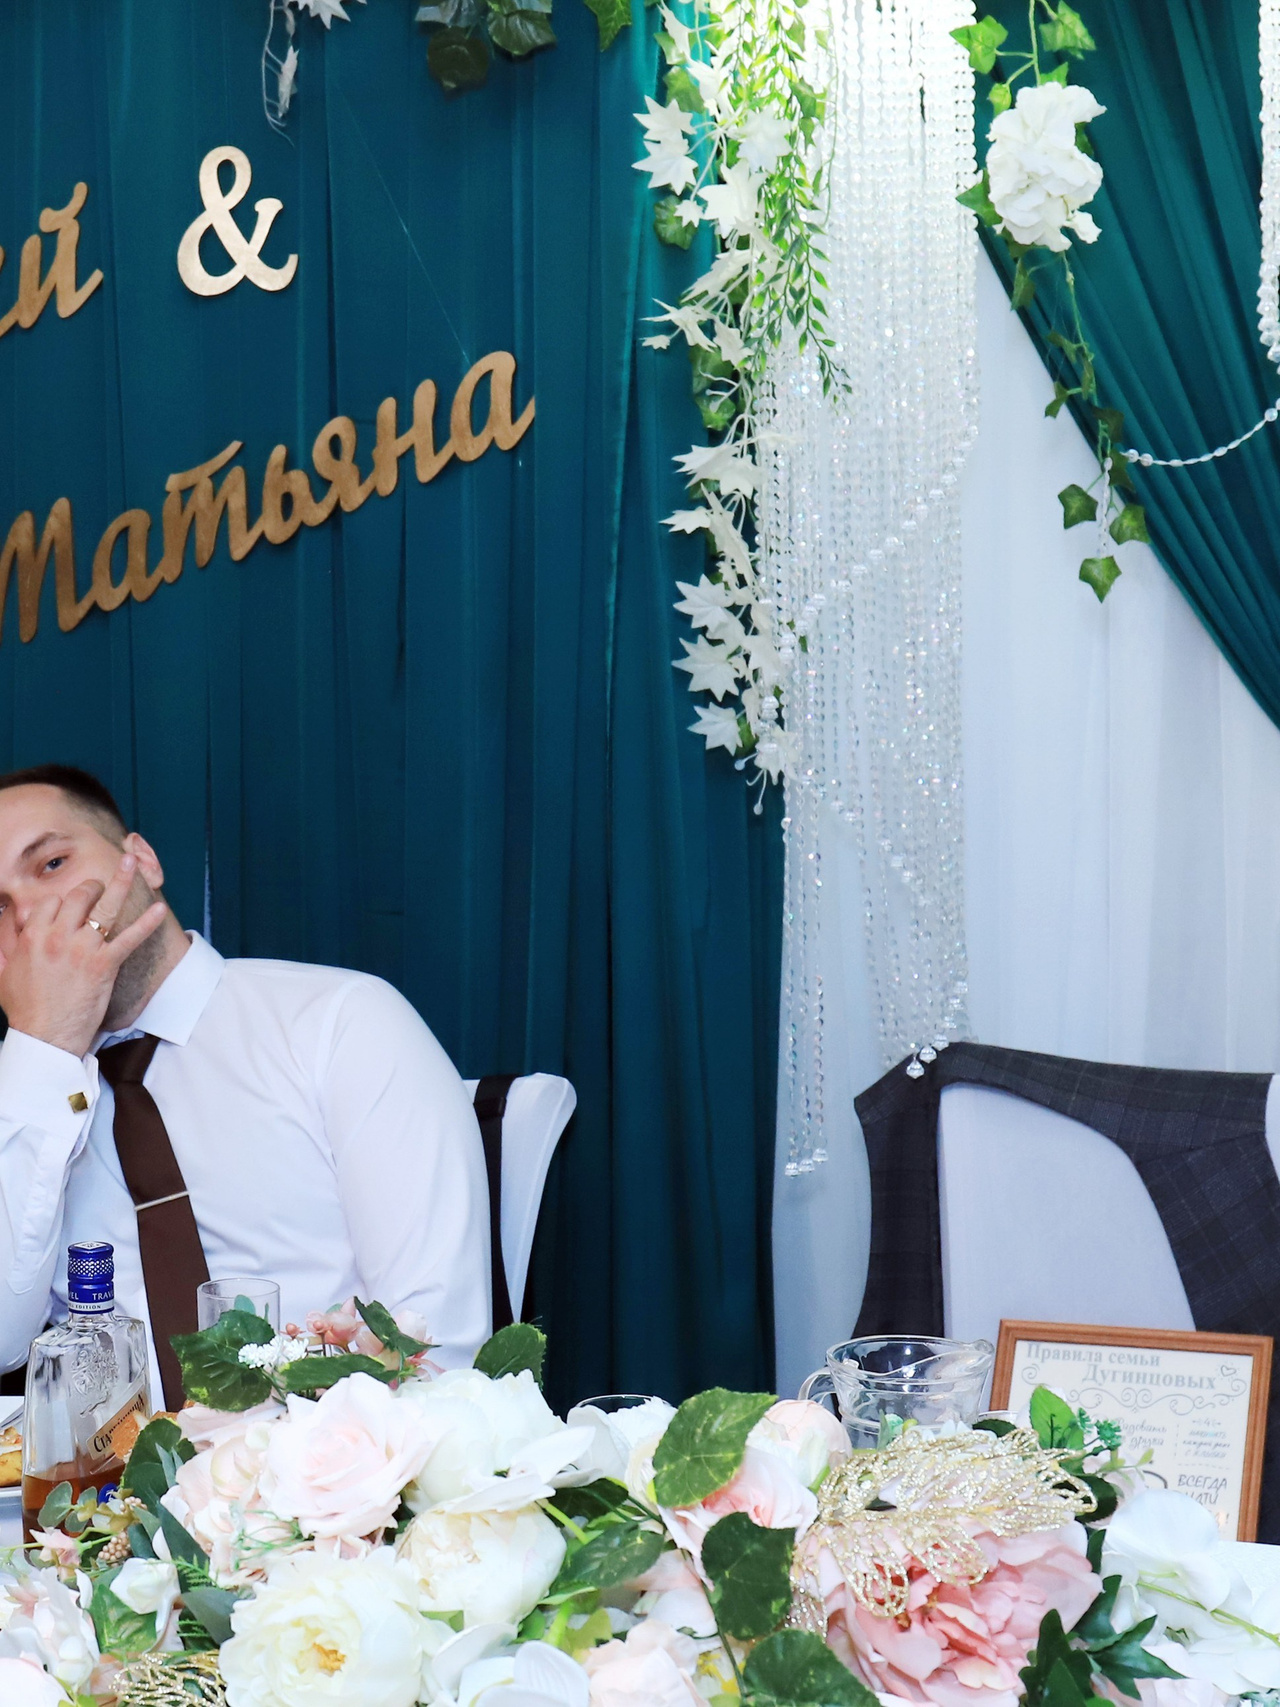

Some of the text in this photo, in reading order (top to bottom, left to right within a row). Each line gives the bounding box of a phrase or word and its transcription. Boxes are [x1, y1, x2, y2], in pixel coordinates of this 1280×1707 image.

[177, 145, 299, 297] &
[1026, 1342, 1161, 1367] Правила семьи
[1081, 1363, 1217, 1391] Дугинцовых
[1176, 1474, 1228, 1493] ВСЕГДА
